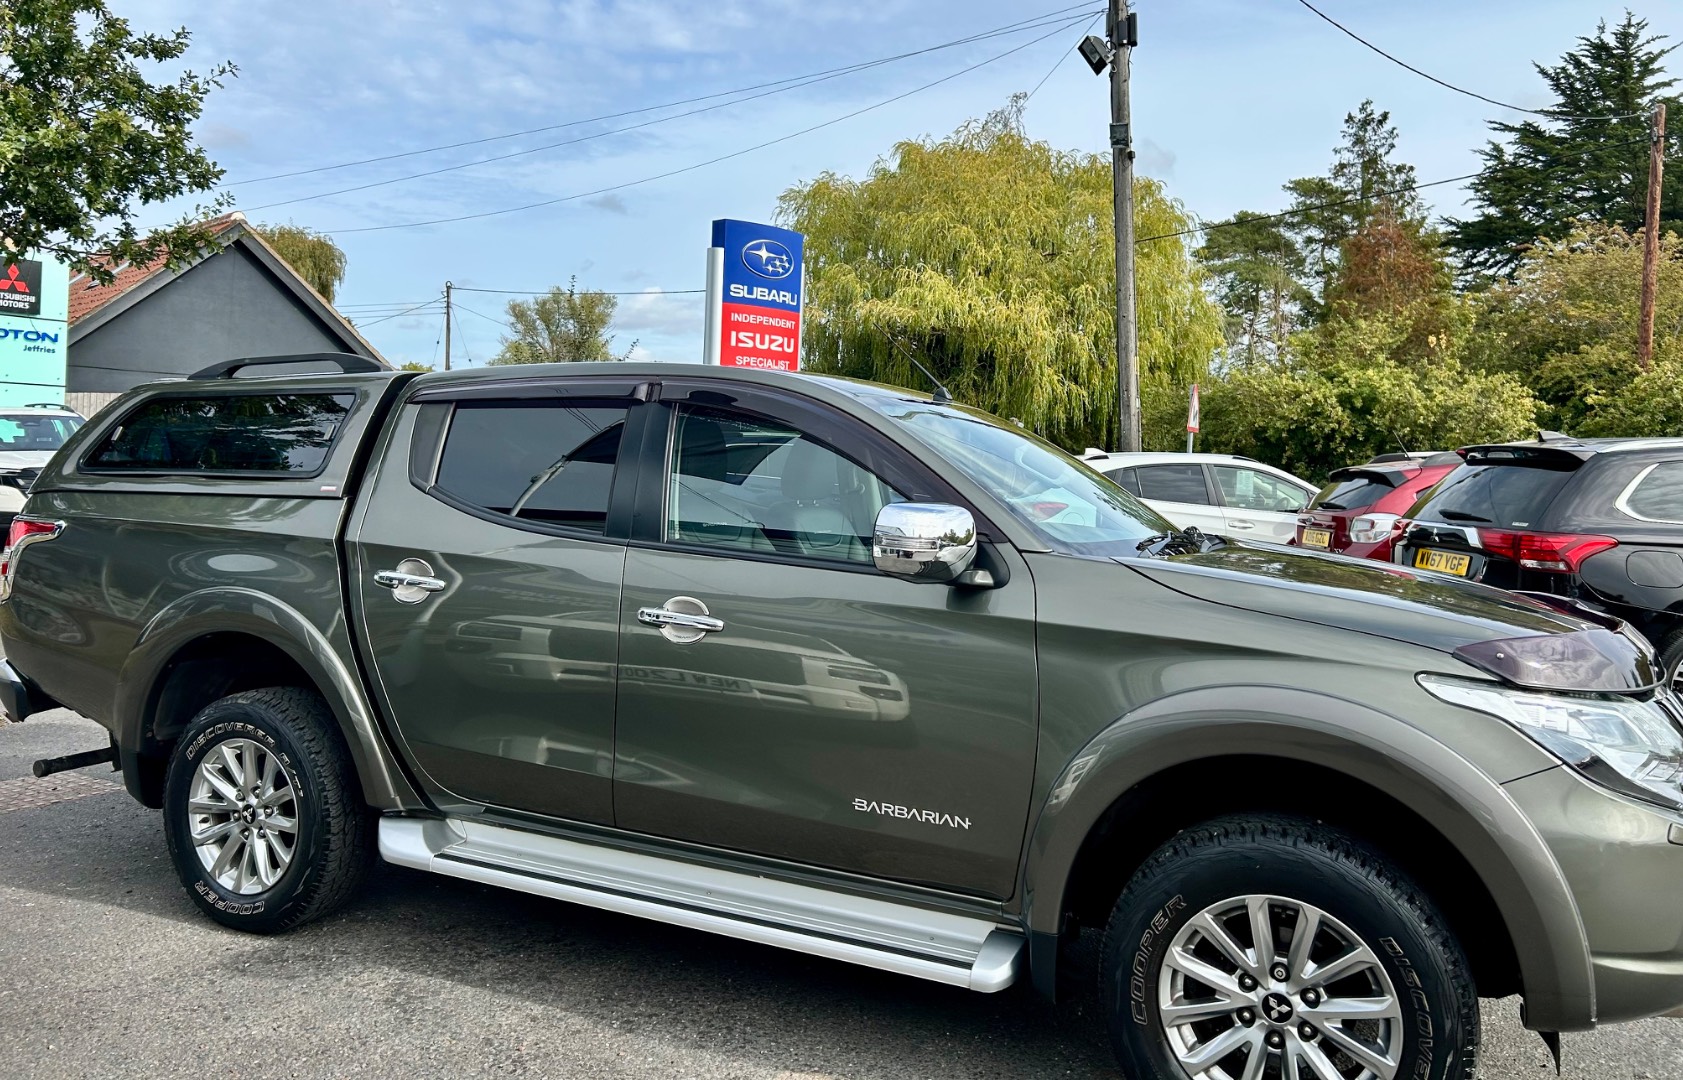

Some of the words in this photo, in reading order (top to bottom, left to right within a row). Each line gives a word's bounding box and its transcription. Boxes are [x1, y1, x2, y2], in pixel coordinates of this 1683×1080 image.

[0, 292, 36, 303] TSUBISHI
[729, 284, 798, 306] SUBARU
[730, 312, 796, 329] INDEPENDENT
[23, 345, 56, 354] Jeffries
[730, 331, 795, 353] ISUZU
[735, 355, 790, 371] SPECIALIST
[1419, 551, 1443, 568] WV67
[1444, 554, 1464, 572] YGF
[186, 721, 276, 760] DISCOVERER
[852, 798, 972, 830] BARBARIAN
[194, 880, 265, 915] COOPER
[1130, 894, 1187, 1025] COOPER
[1379, 936, 1433, 1080] DISCOVE
